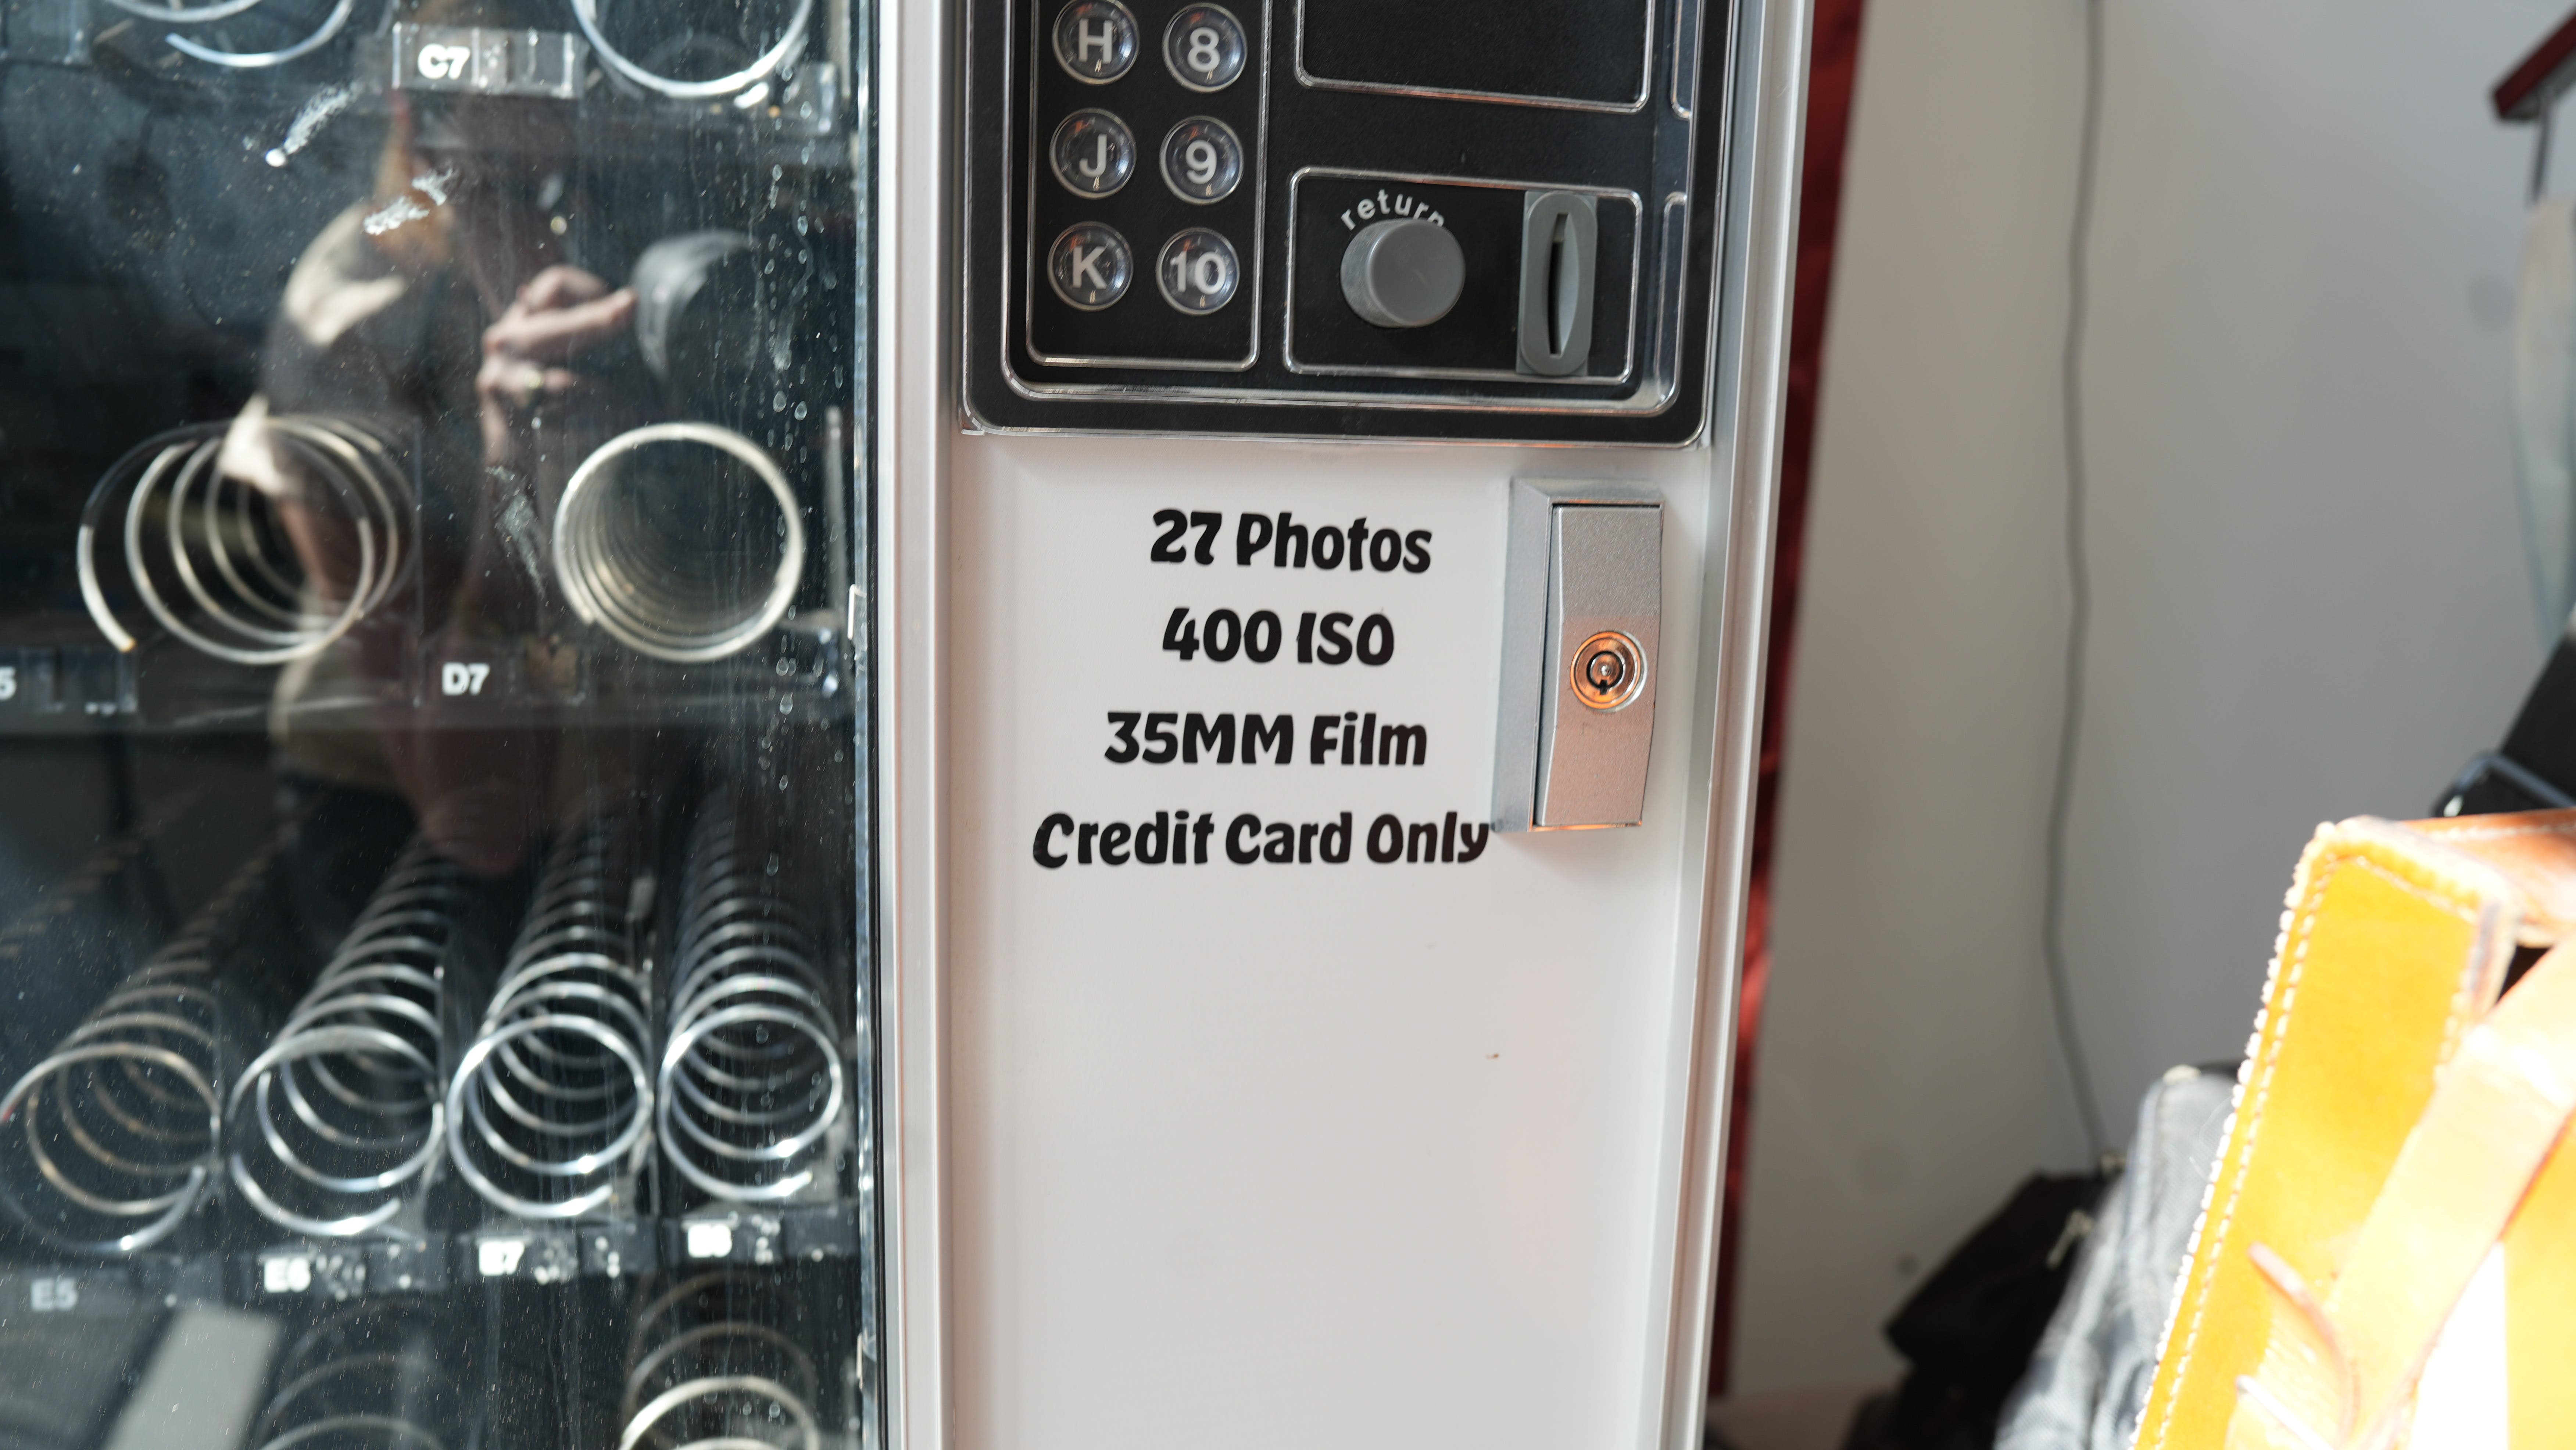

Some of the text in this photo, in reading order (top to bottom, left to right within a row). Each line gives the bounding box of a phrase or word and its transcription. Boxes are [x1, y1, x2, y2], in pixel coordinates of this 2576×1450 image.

[418, 43, 471, 80] C7
[1078, 18, 1113, 64] H
[1187, 27, 1220, 72] 8
[1079, 134, 1107, 177] J
[1185, 140, 1217, 184] 9
[1072, 246, 1106, 289] K
[1170, 251, 1226, 294] 10
[1151, 509, 1432, 574] 27 Photos
[1162, 607, 1394, 666] 400 ISO
[442, 662, 490, 695] D7
[1104, 711, 1427, 766] 35MM Film
[1033, 810, 1490, 869] Credit Card Only
[264, 1257, 311, 1293] E6
[479, 1240, 525, 1276] E7
[31, 1278, 78, 1312] E5
